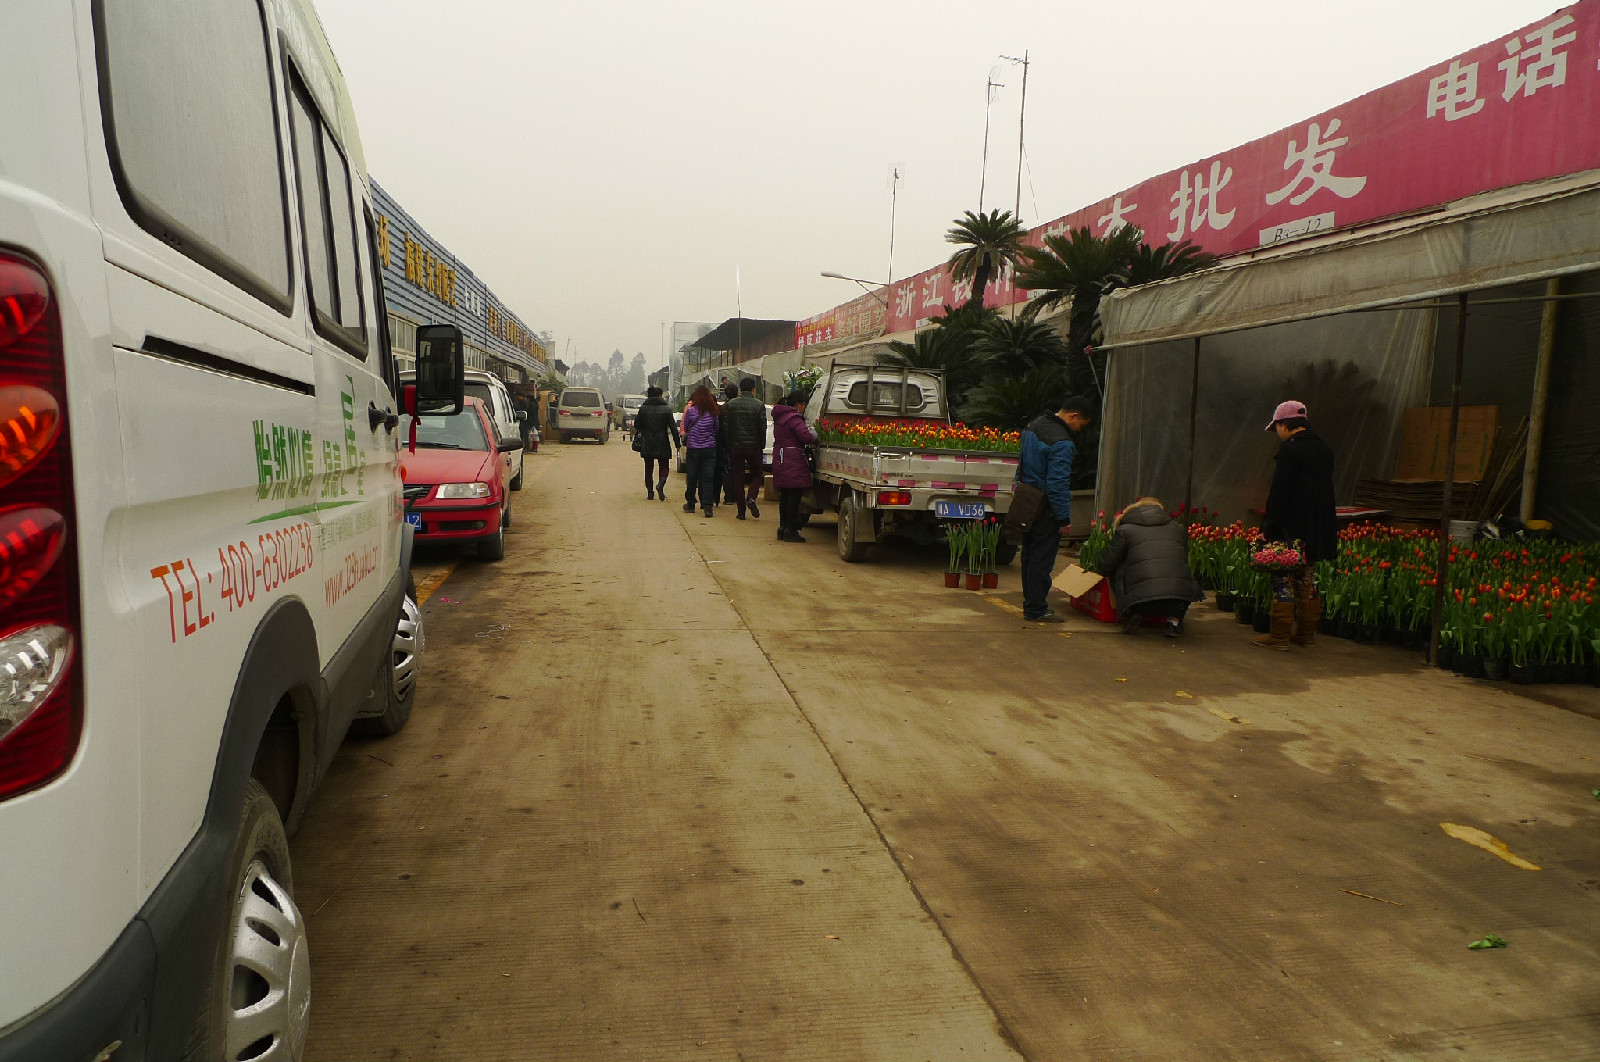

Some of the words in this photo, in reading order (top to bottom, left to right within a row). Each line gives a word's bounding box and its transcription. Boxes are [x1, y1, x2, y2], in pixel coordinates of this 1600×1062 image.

[1427, 14, 1577, 121] 电话
[150, 557, 216, 644] TEL:
[218, 521, 314, 613] 400-6302258
